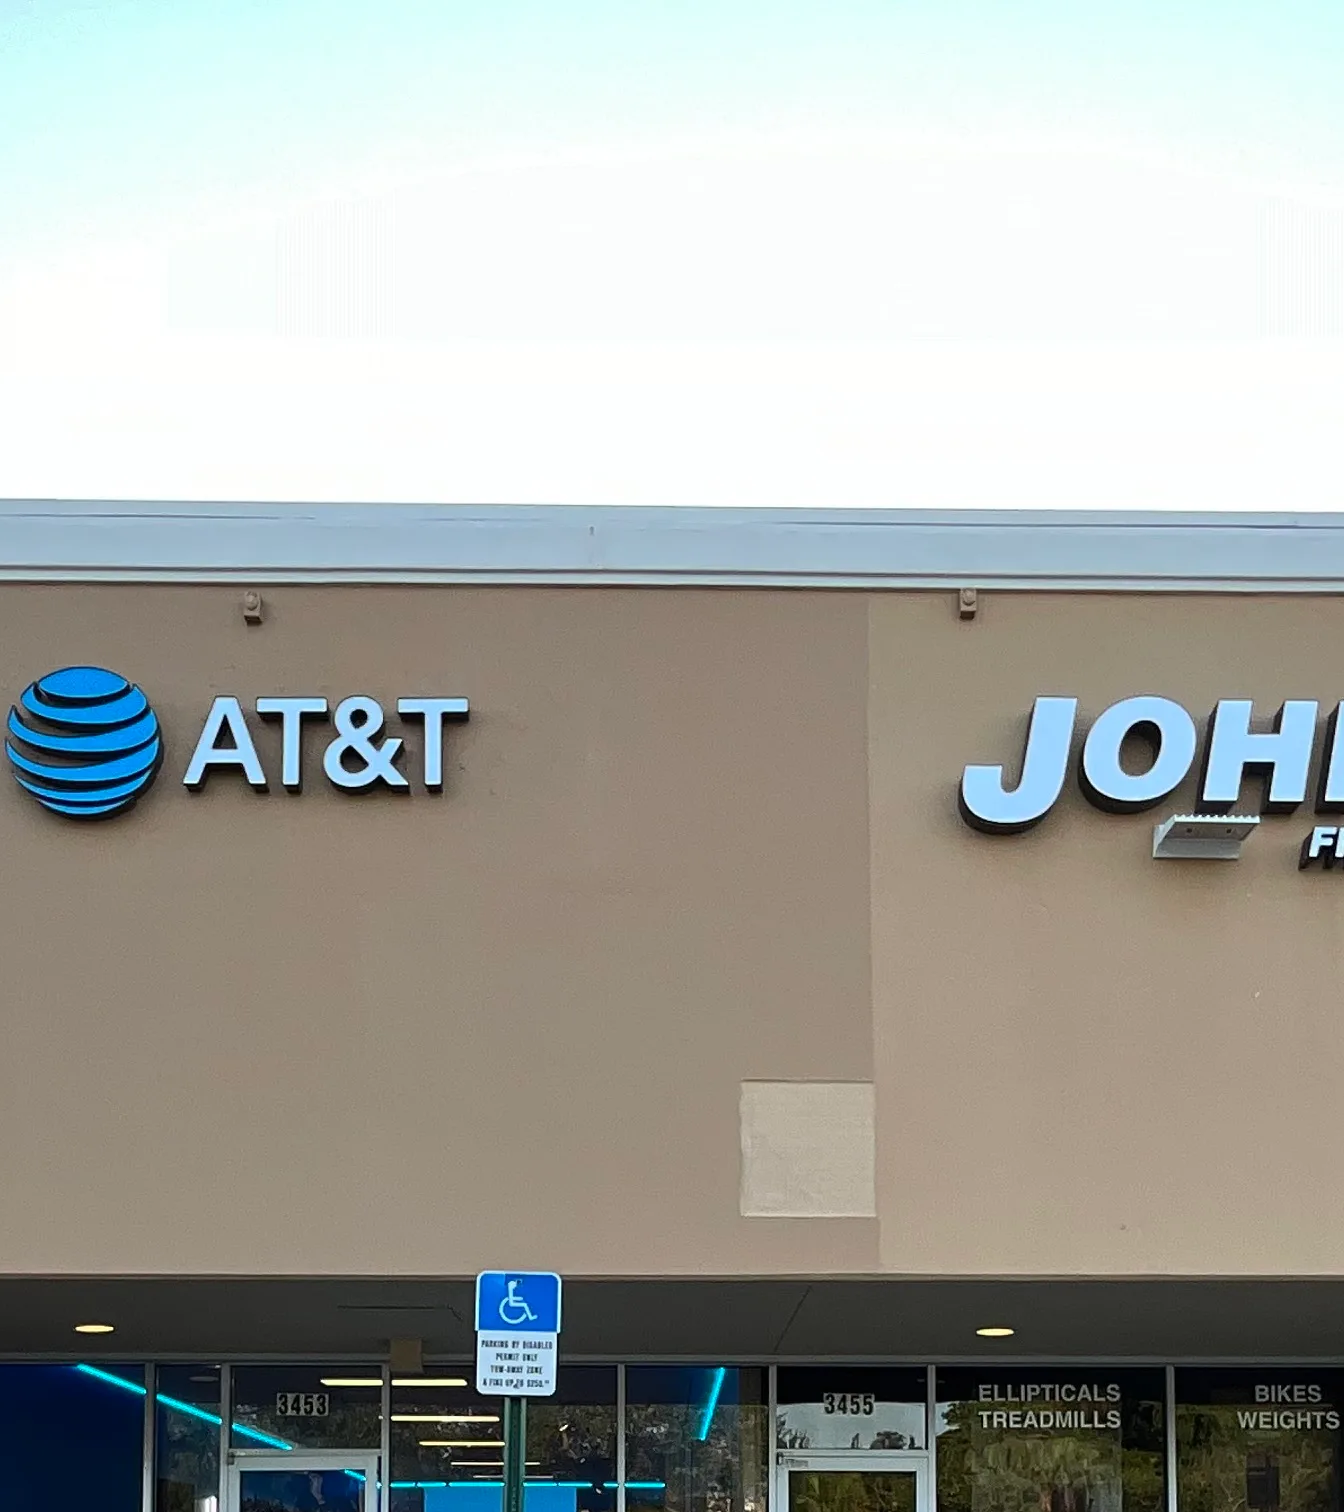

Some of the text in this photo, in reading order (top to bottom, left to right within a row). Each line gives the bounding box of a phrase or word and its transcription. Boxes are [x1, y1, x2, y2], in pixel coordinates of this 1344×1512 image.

[183, 696, 469, 788] AT&T
[978, 1383, 1121, 1402] ELLIPTICALS
[1254, 1384, 1323, 1403] BIKES
[278, 1394, 327, 1415] 3453
[824, 1393, 874, 1416] 3455
[978, 1410, 1121, 1429] TREADMILLS
[1236, 1410, 1341, 1430] WEIGHTS
